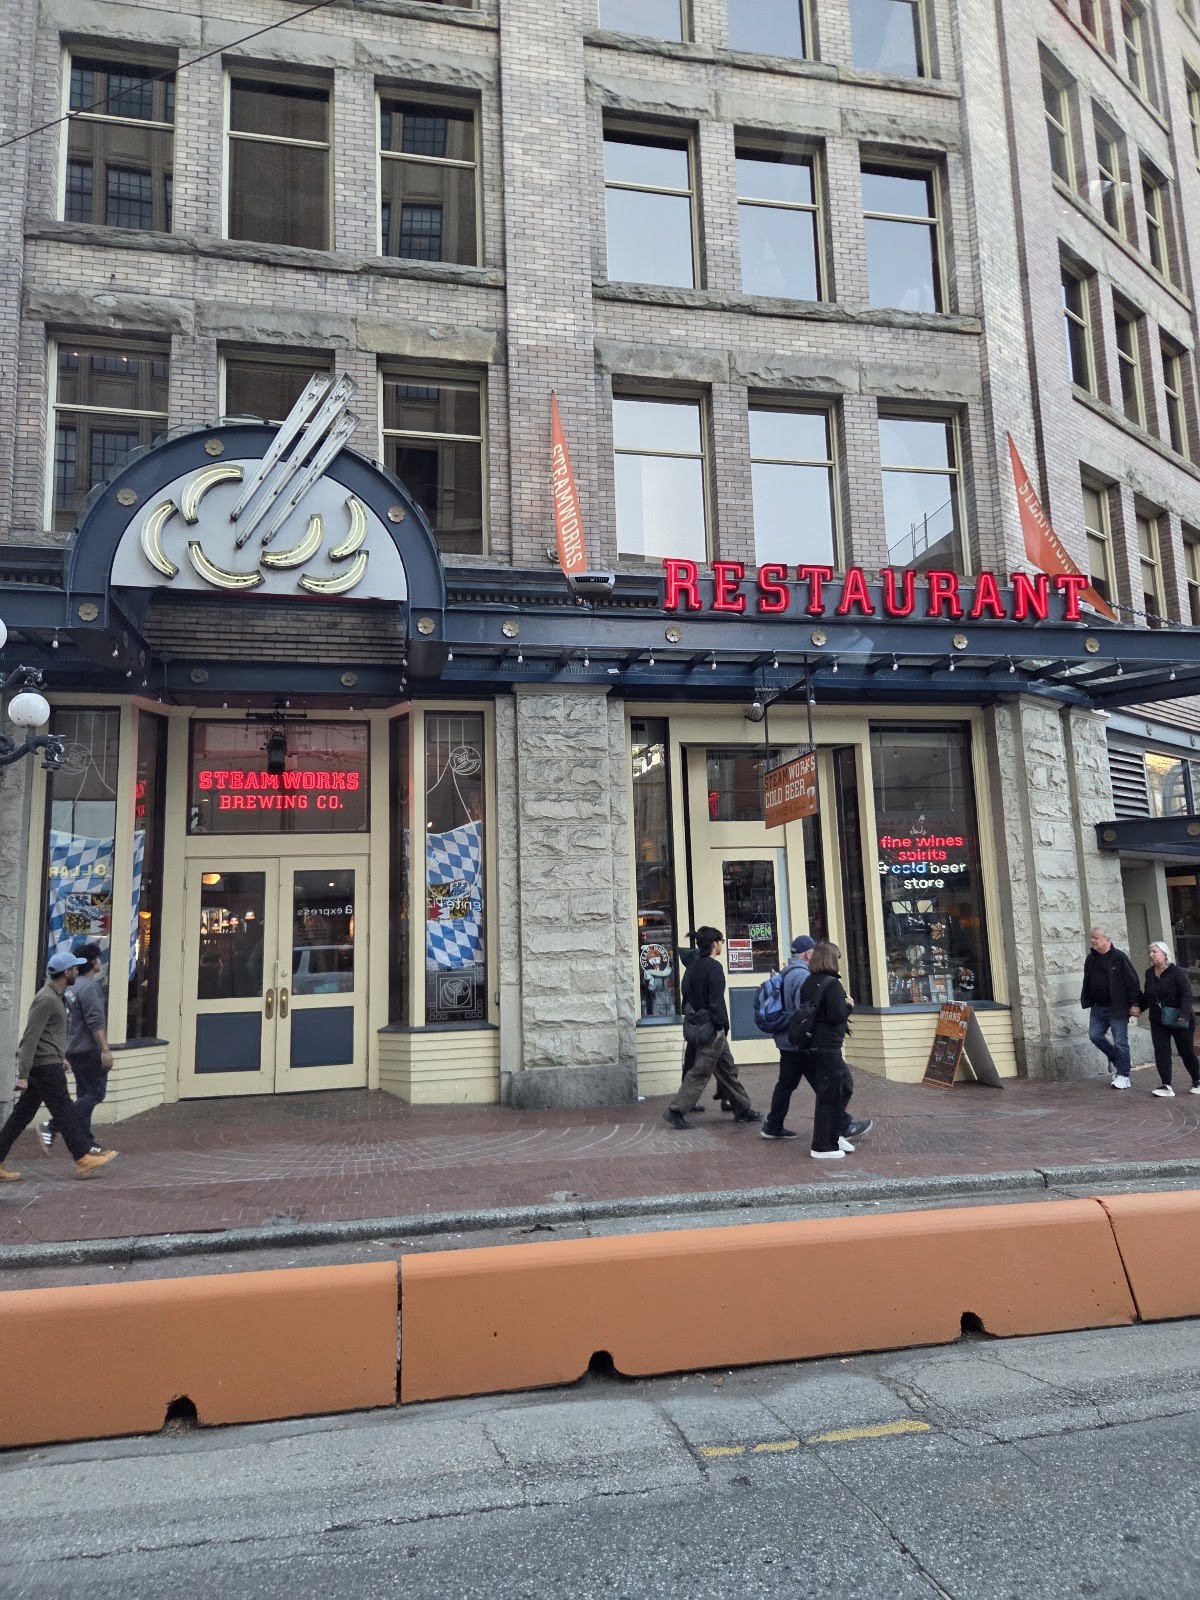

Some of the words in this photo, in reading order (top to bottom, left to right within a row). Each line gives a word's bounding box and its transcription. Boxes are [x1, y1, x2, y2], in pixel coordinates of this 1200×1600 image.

[662, 558, 1089, 621] RESTAURANT
[765, 787, 783, 809] COLD
[785, 778, 806, 802] BEER
[219, 795, 308, 810] BREWING
[316, 795, 343, 810] CO.
[881, 836, 912, 849] fine
[916, 835, 964, 847] wines
[898, 849, 947, 861] spirits
[891, 862, 928, 874] cold
[930, 862, 966, 874] beer
[903, 878, 945, 890] store
[750, 927, 771, 938] OPEN
